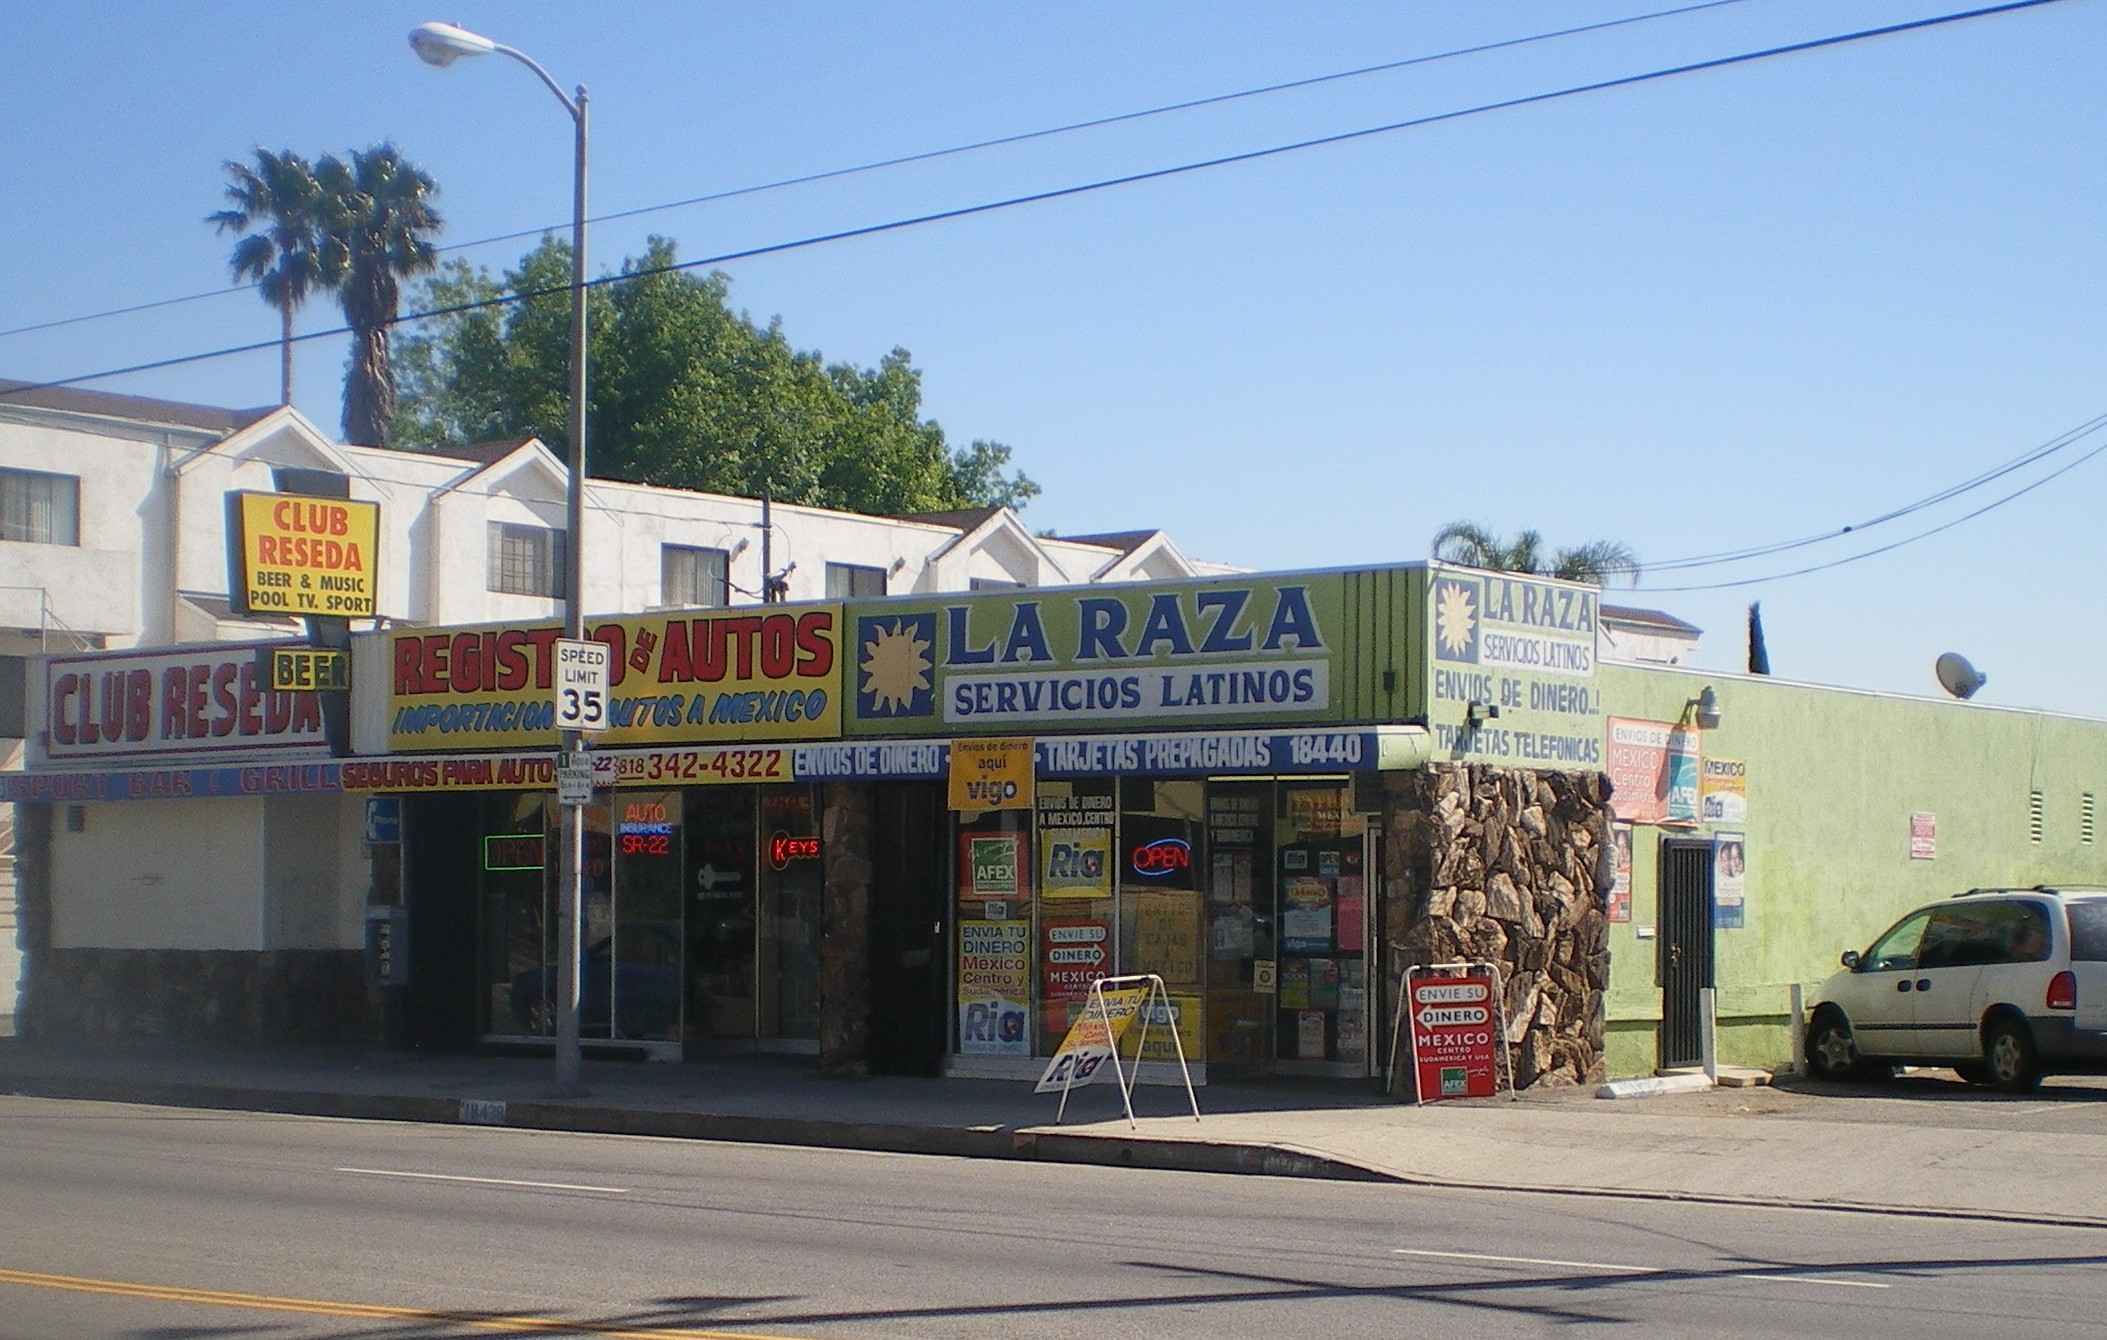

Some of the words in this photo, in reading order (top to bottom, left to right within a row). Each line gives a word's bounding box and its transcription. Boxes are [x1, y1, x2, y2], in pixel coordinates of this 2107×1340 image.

[274, 501, 348, 536] CLUB
[259, 536, 362, 571] RESEDA
[257, 572, 291, 588] BEER
[300, 574, 311, 589] &
[320, 575, 364, 592] MUSIC
[250, 590, 289, 607] POOL
[327, 595, 372, 613] SPORT
[1483, 576, 1515, 622] LA
[1522, 583, 1593, 632] RAZA
[943, 601, 1058, 666] LA
[1073, 585, 1331, 664] RAZA
[394, 624, 626, 696] REGISTO
[629, 626, 658, 675] DE
[658, 612, 833, 684] AUTOS
[561, 649, 605, 665] SPEED
[1484, 634, 1540, 665] SERVICIOS
[1543, 641, 1589, 671] LATINOS
[565, 668, 598, 684] LIMIT
[955, 676, 1140, 716] SERVICIOS
[1161, 669, 1313, 708] LATINOS
[1435, 669, 1492, 704] ENVIOS
[1501, 677, 1522, 708] DE
[54, 669, 151, 745] CLUB
[161, 662, 321, 739] RESEDA
[392, 701, 555, 735] IMPORTACION
[687, 694, 706, 725] A
[709, 688, 828, 725] MEXICO
[562, 689, 602, 722] 35
[987, 742, 998, 752] de
[1000, 742, 1028, 752] dinero
[1435, 723, 1509, 757] TARJETAS
[1514, 731, 1599, 763] TELEFONICAS
[1616, 728, 1647, 743] ENVIOS
[1651, 732, 1661, 745] DE
[794, 748, 850, 776] ENVIOS
[854, 747, 877, 775] DE
[880, 745, 940, 774] DINERO
[1045, 740, 1140, 772] TARJETAS
[1145, 737, 1271, 769] PREPAGADAS
[1289, 734, 1361, 764] 18440
[1612, 748, 1659, 770] MEXICO
[342, 761, 438, 789] SEGUROS
[443, 759, 492, 786] PARA
[497, 758, 557, 785] AUTO
[618, 758, 644, 774] 818
[648, 750, 780, 779] 342-4322
[1705, 761, 1745, 777] MEXICO
[240, 764, 337, 793] GRILL
[967, 774, 1017, 805] vigo
[625, 803, 666, 822] AUTO
[619, 823, 672, 834] INSURANCE
[623, 835, 669, 854] SR-22
[1049, 842, 1104, 878] Ria
[1133, 846, 1190, 868] OPEN
[977, 865, 1014, 880] AFEX
[963, 926, 1003, 938] ENVIA
[1008, 926, 1026, 938] TU
[1052, 930, 1084, 940] ENVIE
[1090, 928, 1103, 939] SU
[963, 940, 1026, 954] DINERO
[1053, 949, 1102, 961] DINERO
[963, 972, 1012, 985] Centro
[1017, 976, 1024, 987] y
[1050, 970, 1105, 982] MEXICO
[1420, 988, 1461, 1000] ENVIE
[1467, 987, 1484, 998] SU
[965, 1001, 1025, 1043] Ria
[1423, 1010, 1485, 1023] DINERO
[1419, 1032, 1488, 1046] MEXICO
[1046, 1051, 1103, 1081] Ria
[1444, 1079, 1465, 1089] AFEX
